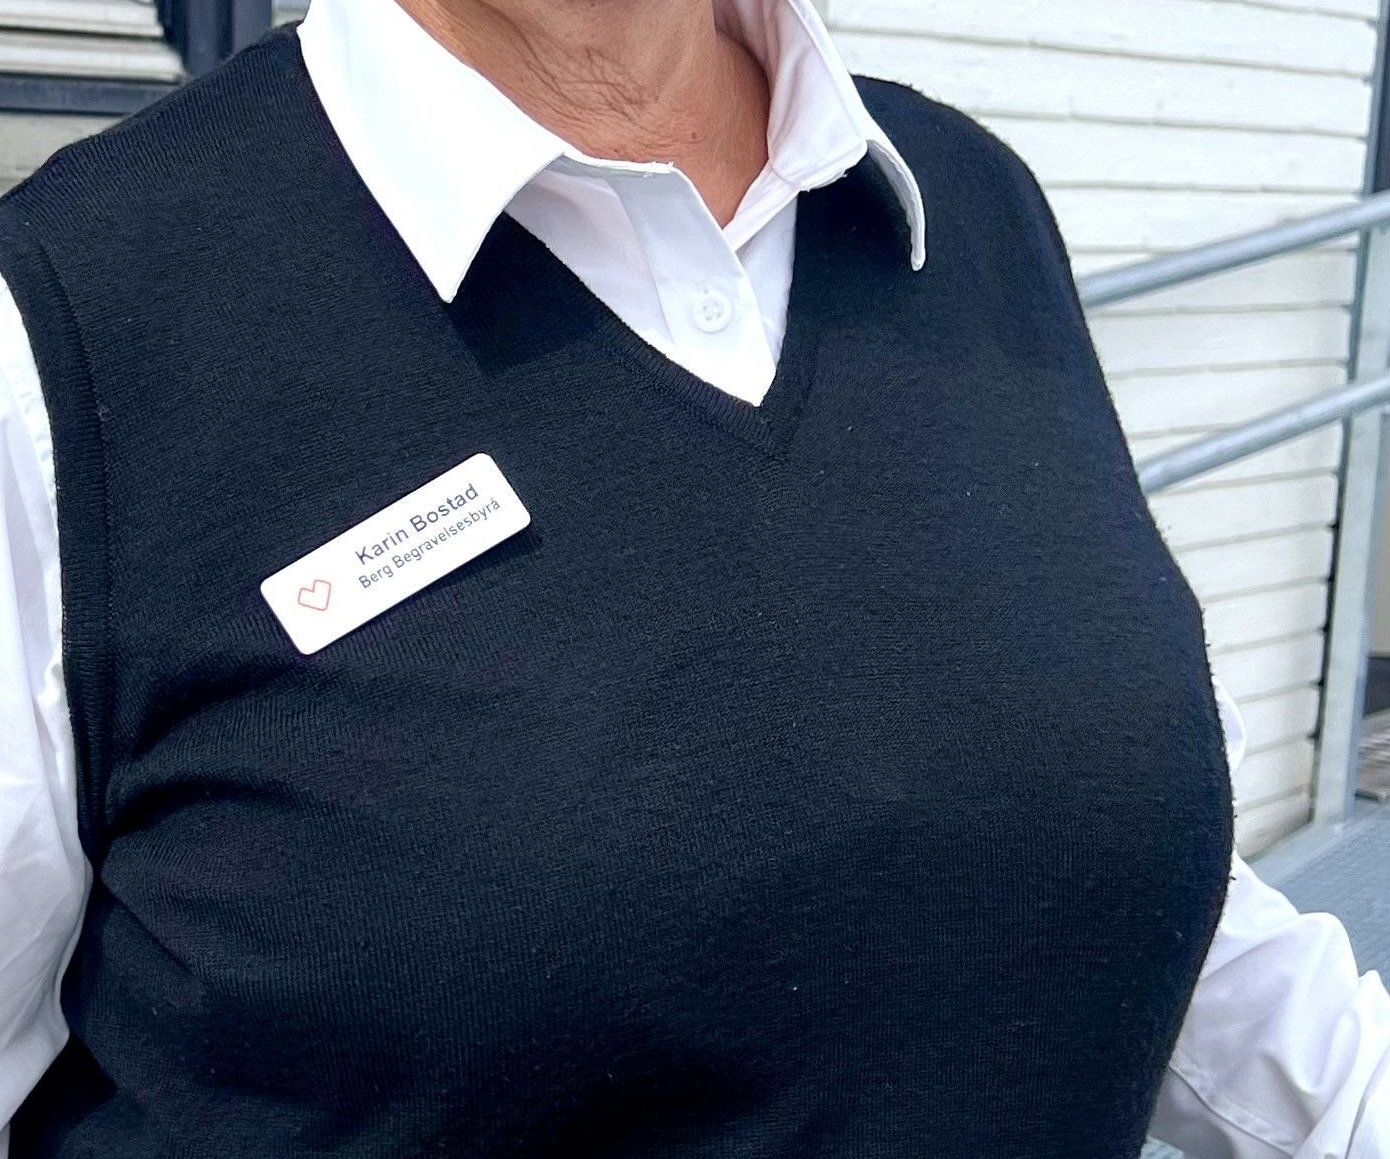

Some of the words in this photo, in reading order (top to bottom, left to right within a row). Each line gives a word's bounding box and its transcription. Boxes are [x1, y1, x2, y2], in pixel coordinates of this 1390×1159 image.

[355, 527, 409, 566] Karin
[410, 483, 479, 533] Bostad
[358, 564, 394, 589] Berg
[392, 496, 501, 570] Begravelsesbyrå
